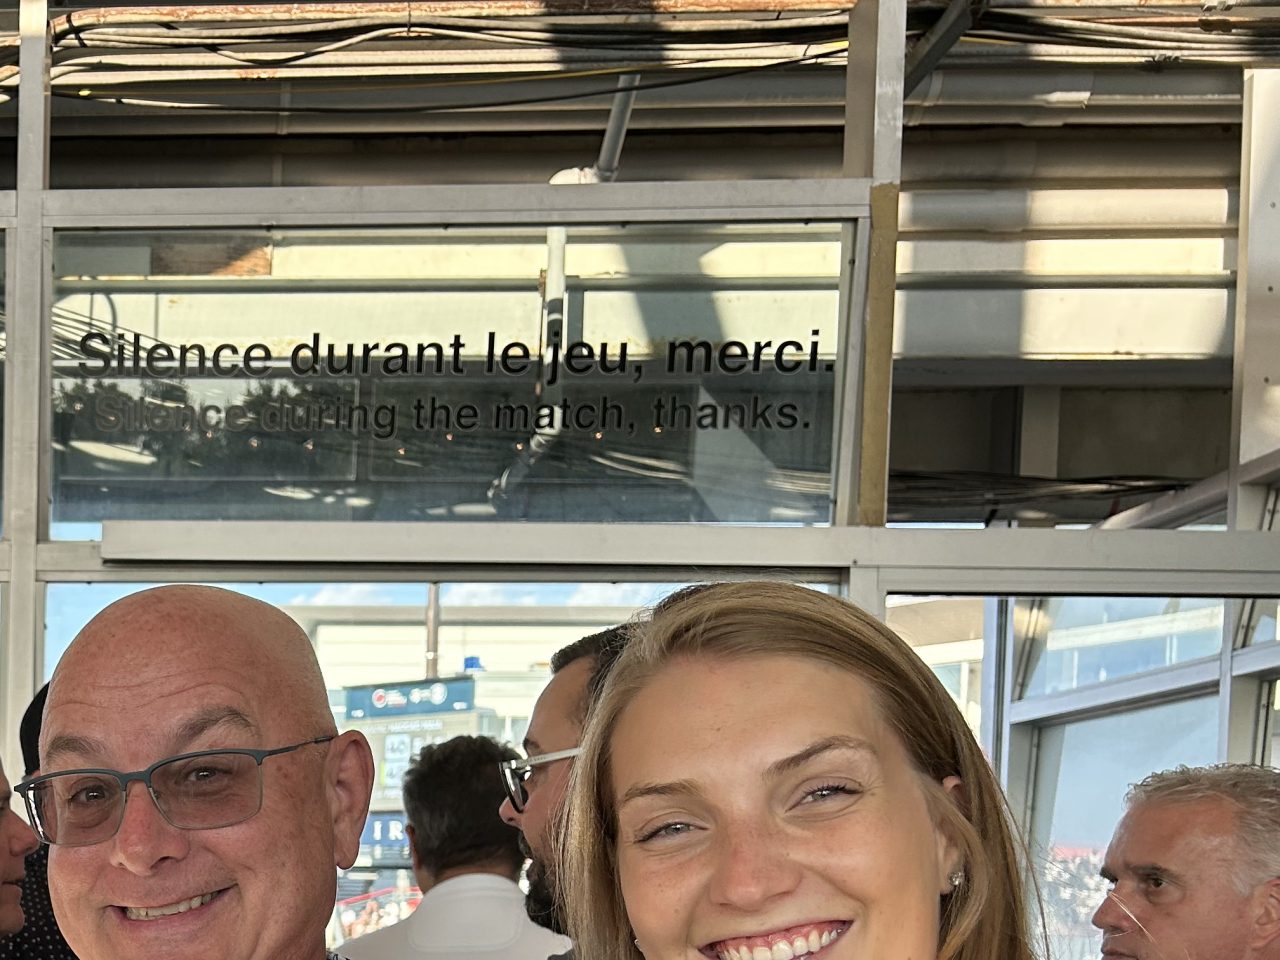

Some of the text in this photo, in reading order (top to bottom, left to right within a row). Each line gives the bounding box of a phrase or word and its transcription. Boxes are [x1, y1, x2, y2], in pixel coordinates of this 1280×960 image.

[78, 329, 835, 386] Silence durant le jeu, merci.
[96, 395, 810, 438] Silence during the match, thanks.
